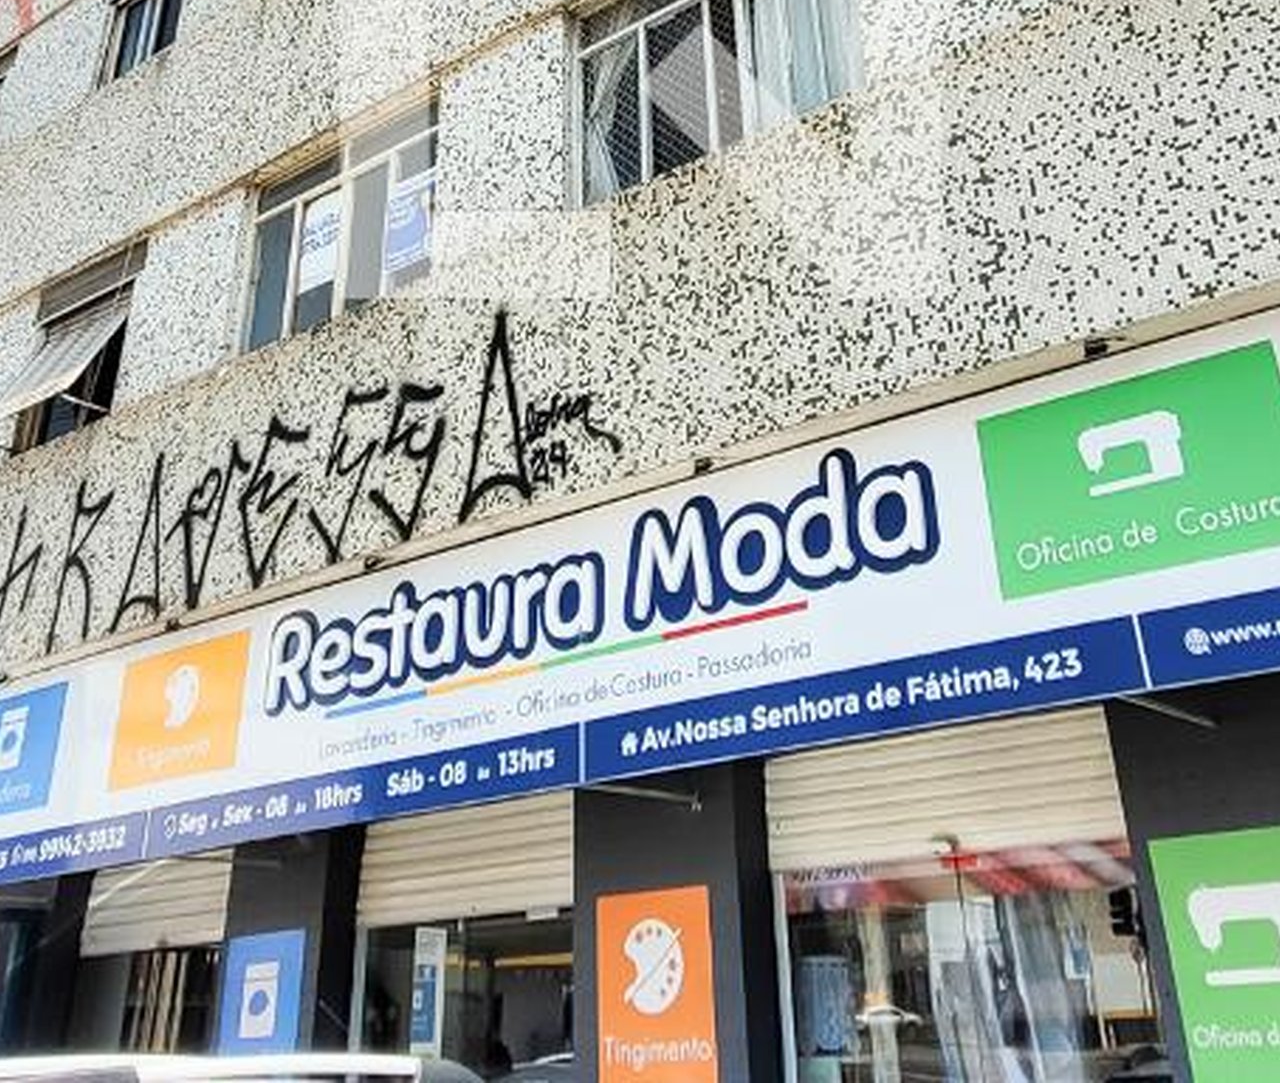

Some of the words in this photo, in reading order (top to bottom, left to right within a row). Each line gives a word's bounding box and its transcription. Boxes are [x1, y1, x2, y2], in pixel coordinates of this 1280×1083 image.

[1017, 533, 1114, 571] Oficina
[1123, 520, 1158, 550] de
[263, 551, 606, 717] Restaura
[623, 448, 942, 630] Moda
[585, 679, 607, 702] de
[697, 638, 812, 679] Passadoria
[750, 689, 861, 731] Senhora
[866, 680, 902, 711] de
[907, 665, 1020, 703] Fátima,
[1023, 647, 1083, 684] 423
[386, 767, 425, 797] Sáb
[439, 760, 467, 788] 08
[497, 747, 556, 778] 13hrs
[178, 813, 209, 836] Seg
[223, 804, 253, 827] Sex
[265, 794, 290, 819] 08
[315, 783, 363, 810] 18hrs
[603, 1036, 713, 1072] Tingimento
[1192, 1022, 1263, 1049] Oficina
